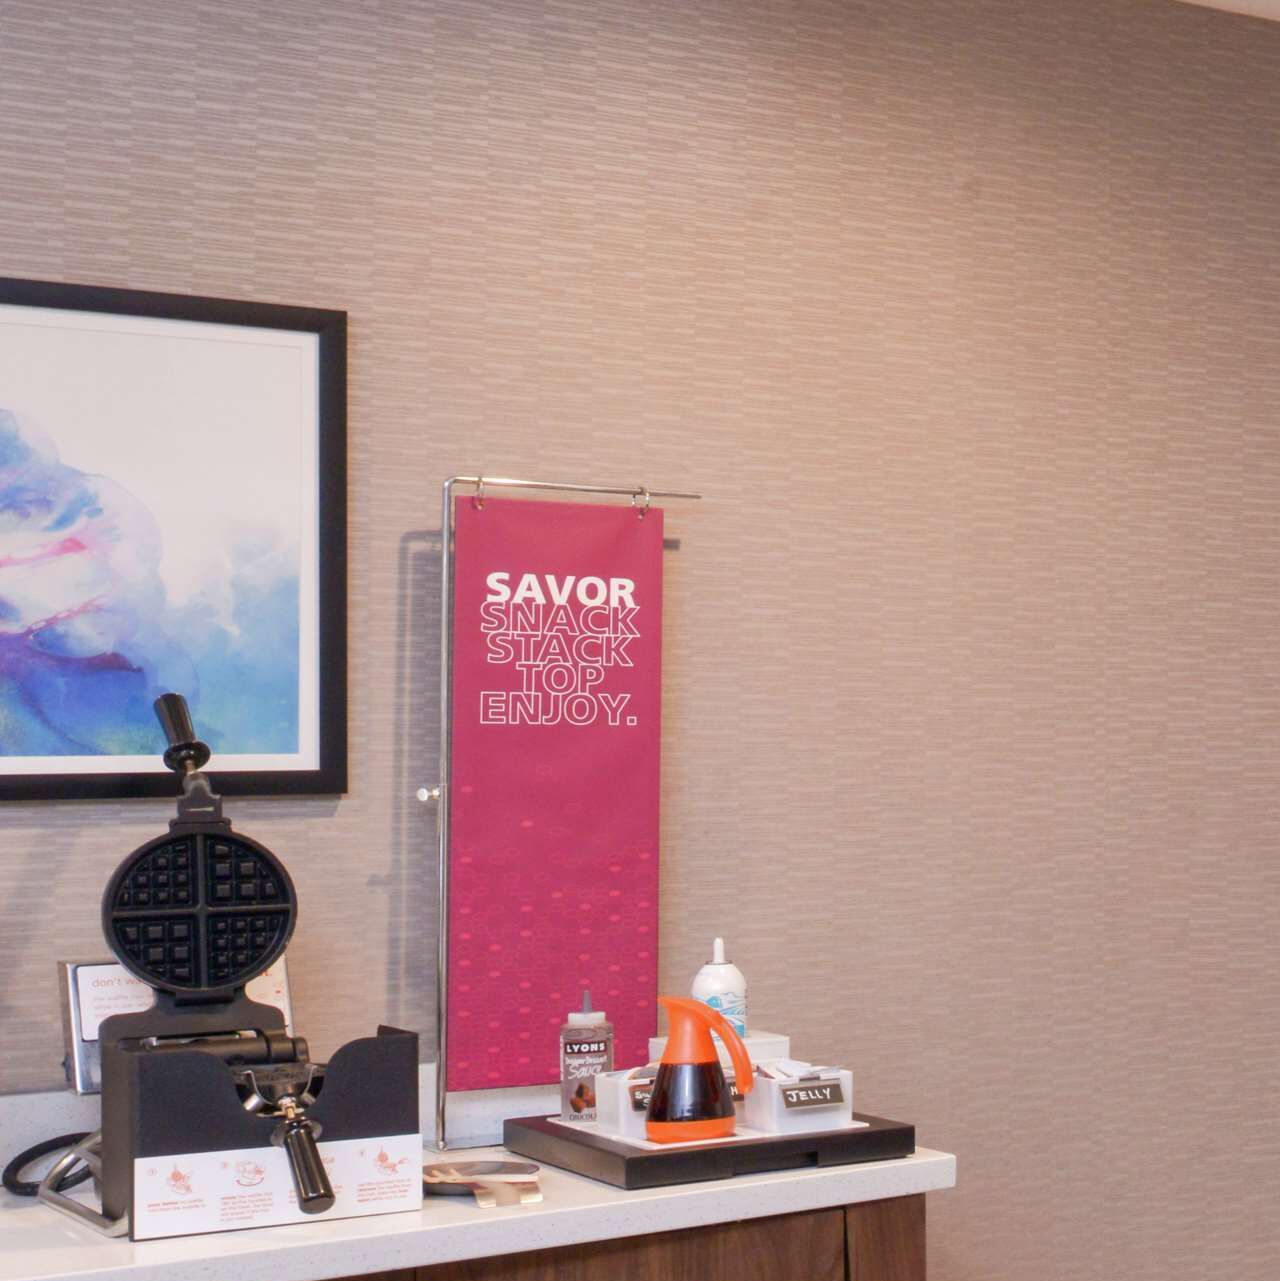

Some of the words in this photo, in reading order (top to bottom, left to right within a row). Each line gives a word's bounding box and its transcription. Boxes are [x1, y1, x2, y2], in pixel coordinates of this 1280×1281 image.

[486, 572, 635, 608] SAVOR
[480, 601, 640, 637] SNACK
[487, 632, 634, 667] STACK
[516, 662, 605, 695] TOP
[480, 691, 637, 726] ENJOY.
[566, 1043, 605, 1053] LYONS
[786, 1087, 831, 1103] JELLY
[569, 1112, 597, 1121] CHOCOL
